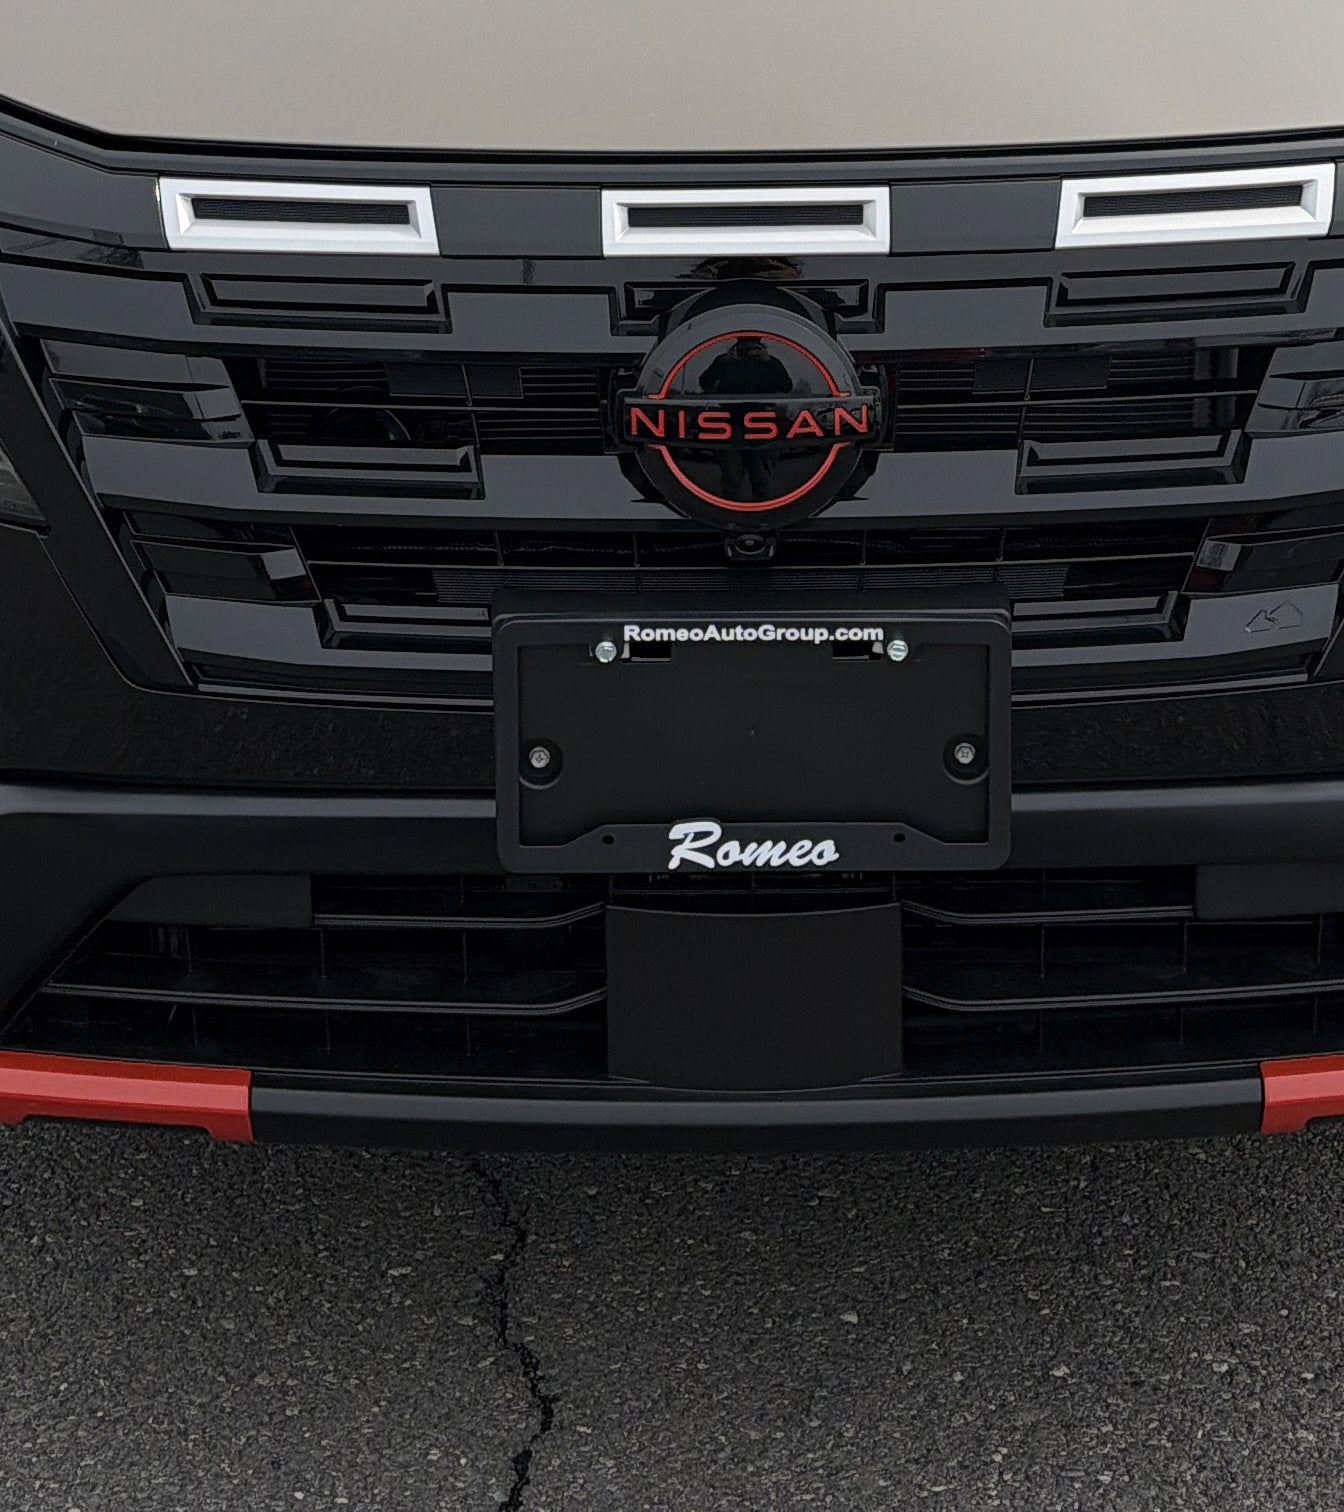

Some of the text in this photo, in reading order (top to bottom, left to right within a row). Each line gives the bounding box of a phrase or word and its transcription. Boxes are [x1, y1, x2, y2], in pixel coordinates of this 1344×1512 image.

[630, 404, 869, 440] NISSAN
[623, 624, 885, 644] RomeoAutoGroup.com
[668, 821, 840, 870] Romeo
